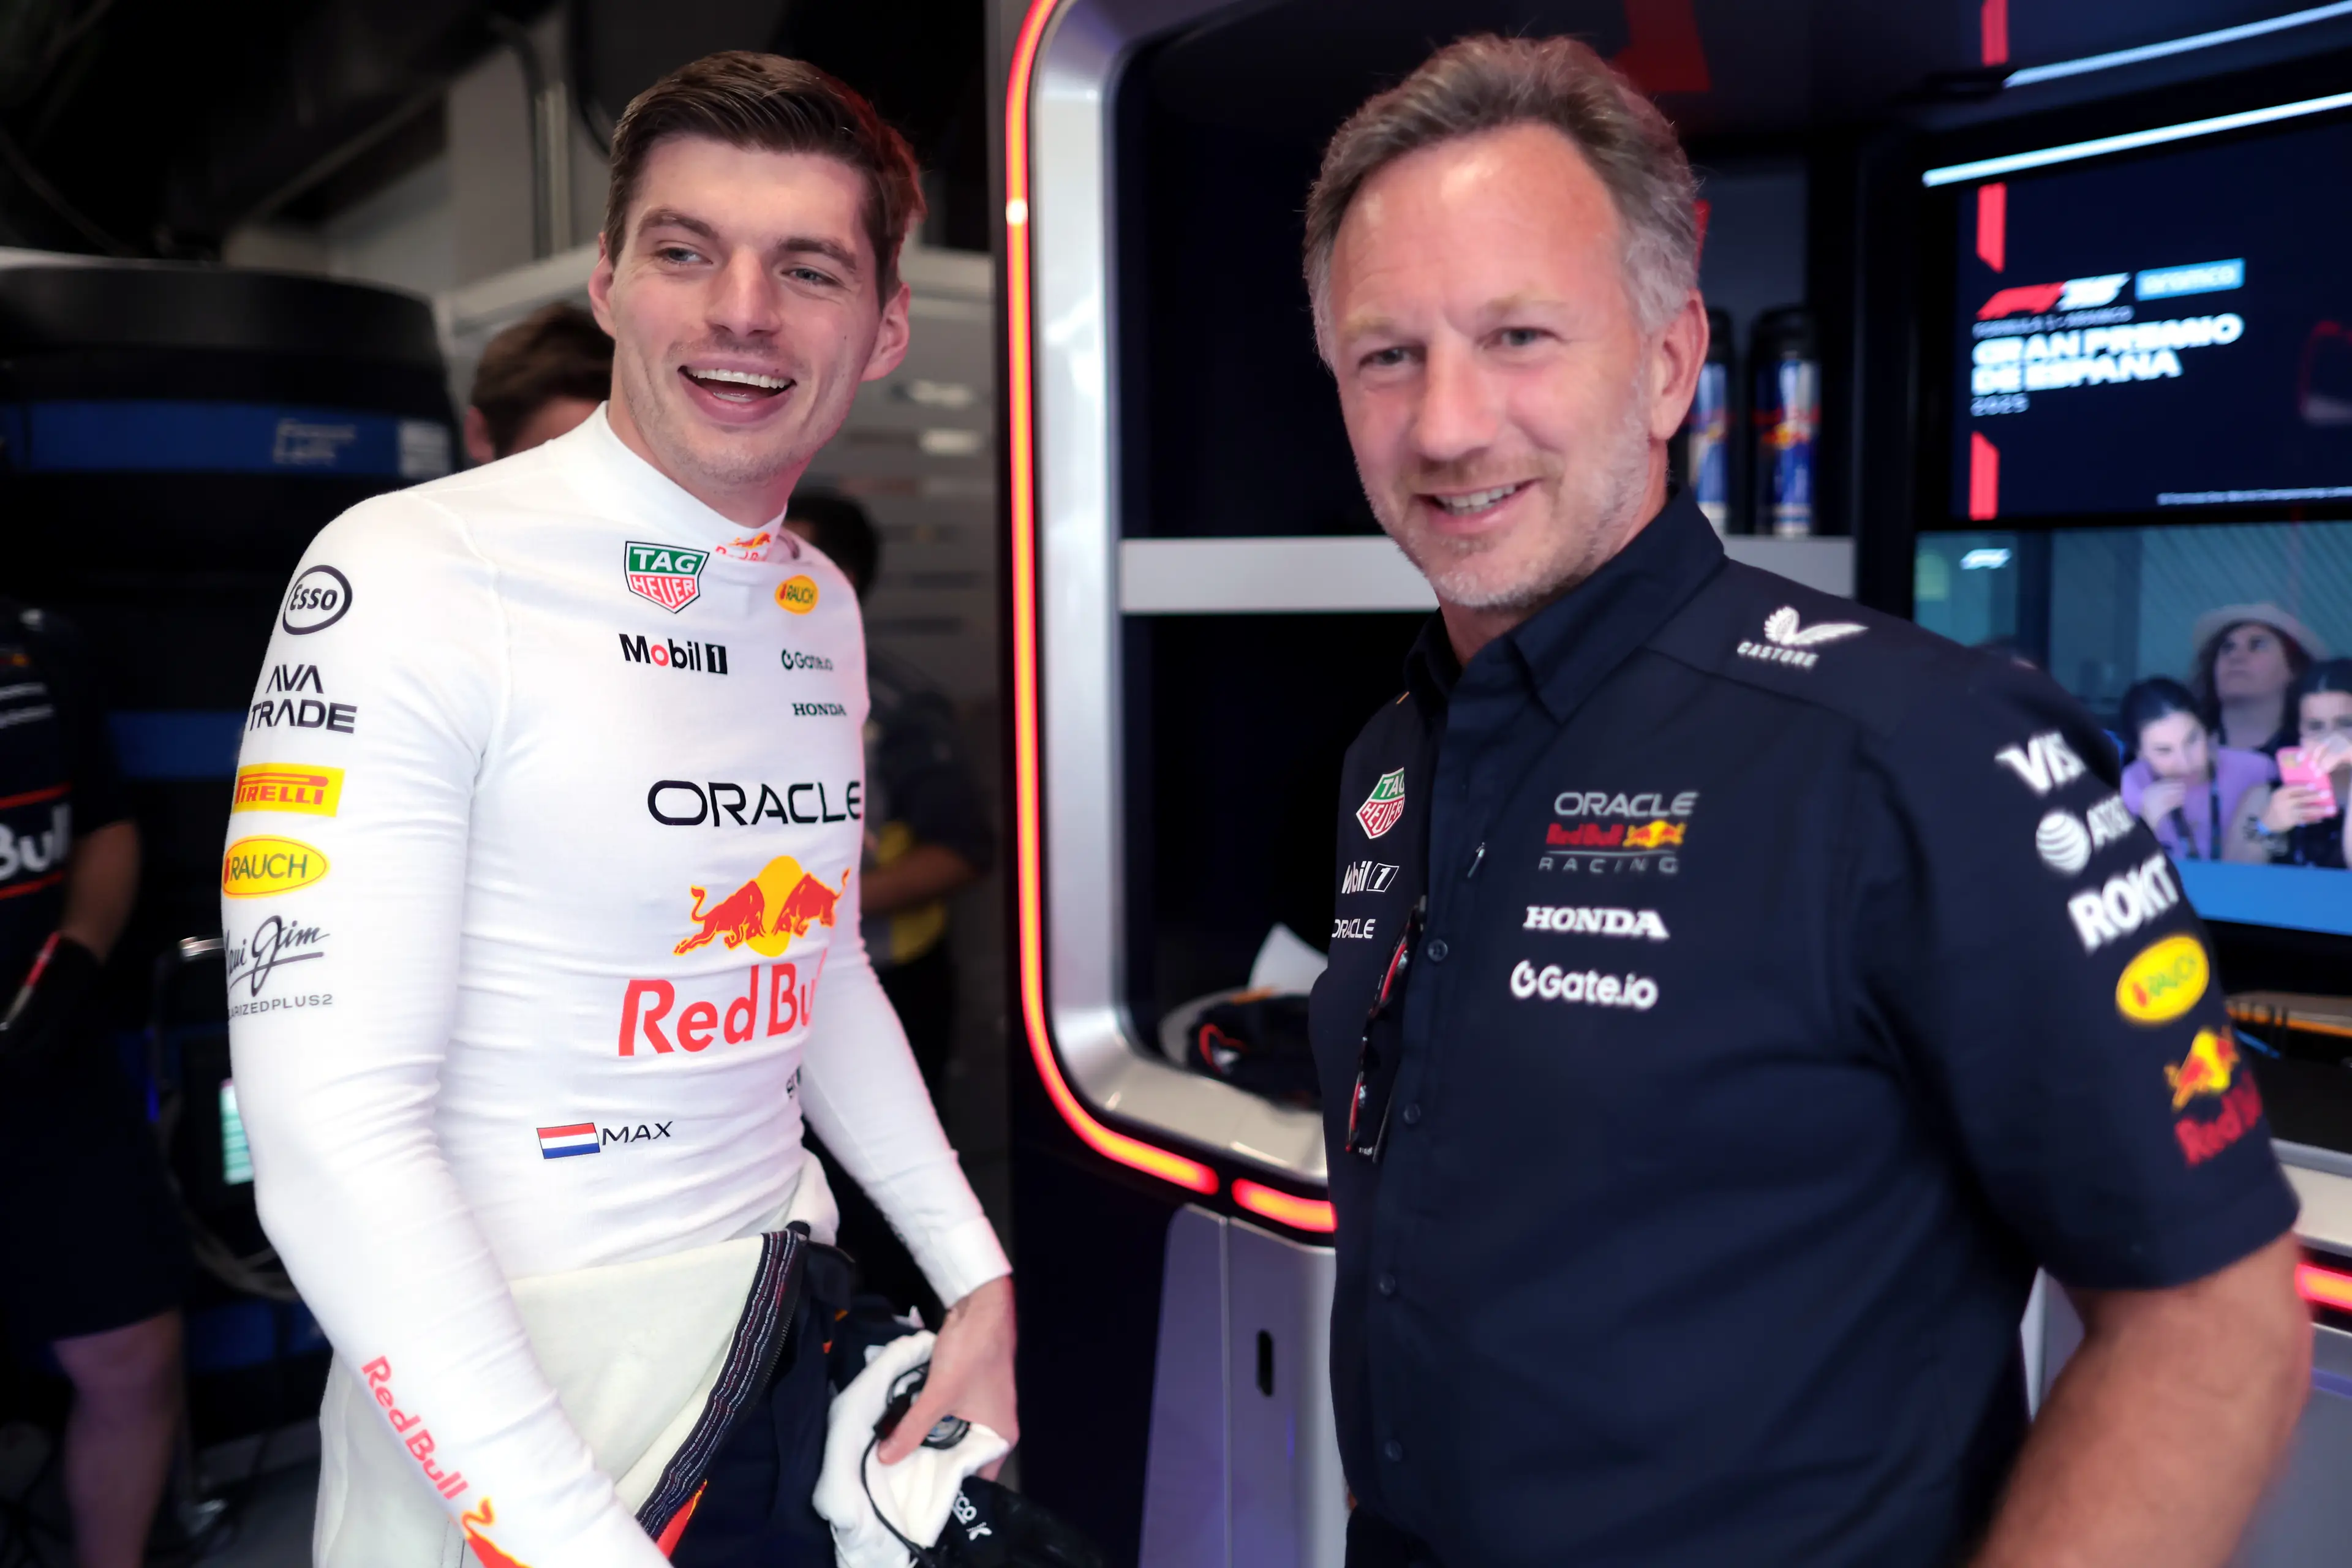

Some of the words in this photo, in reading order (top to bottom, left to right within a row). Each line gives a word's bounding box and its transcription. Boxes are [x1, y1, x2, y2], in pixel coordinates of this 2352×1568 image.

[633, 548, 698, 574] TAG
[632, 576, 695, 609] HEUER
[785, 584, 815, 604] RAUCH
[619, 633, 702, 672] Mobil
[1736, 641, 1819, 668] CASTORE
[265, 664, 324, 694] AVA
[249, 699, 358, 734] TRADE
[792, 703, 846, 716] HONDA
[235, 772, 330, 805] PIRELLI
[647, 780, 862, 827] ORACLE
[1554, 792, 1700, 816] ORACLE
[1362, 800, 1403, 834] HEUER
[230, 853, 308, 882] RAUCH
[1538, 856, 1679, 874] RACING
[2068, 853, 2179, 952] ROKT
[1523, 905, 1670, 940] HONDA
[1537, 964, 1658, 1009] Gate.io
[618, 963, 760, 1057] Red
[767, 961, 818, 1037] Bu
[601, 1121, 674, 1146] MAX
[361, 1355, 422, 1434] Red
[405, 1428, 469, 1501] Bull
